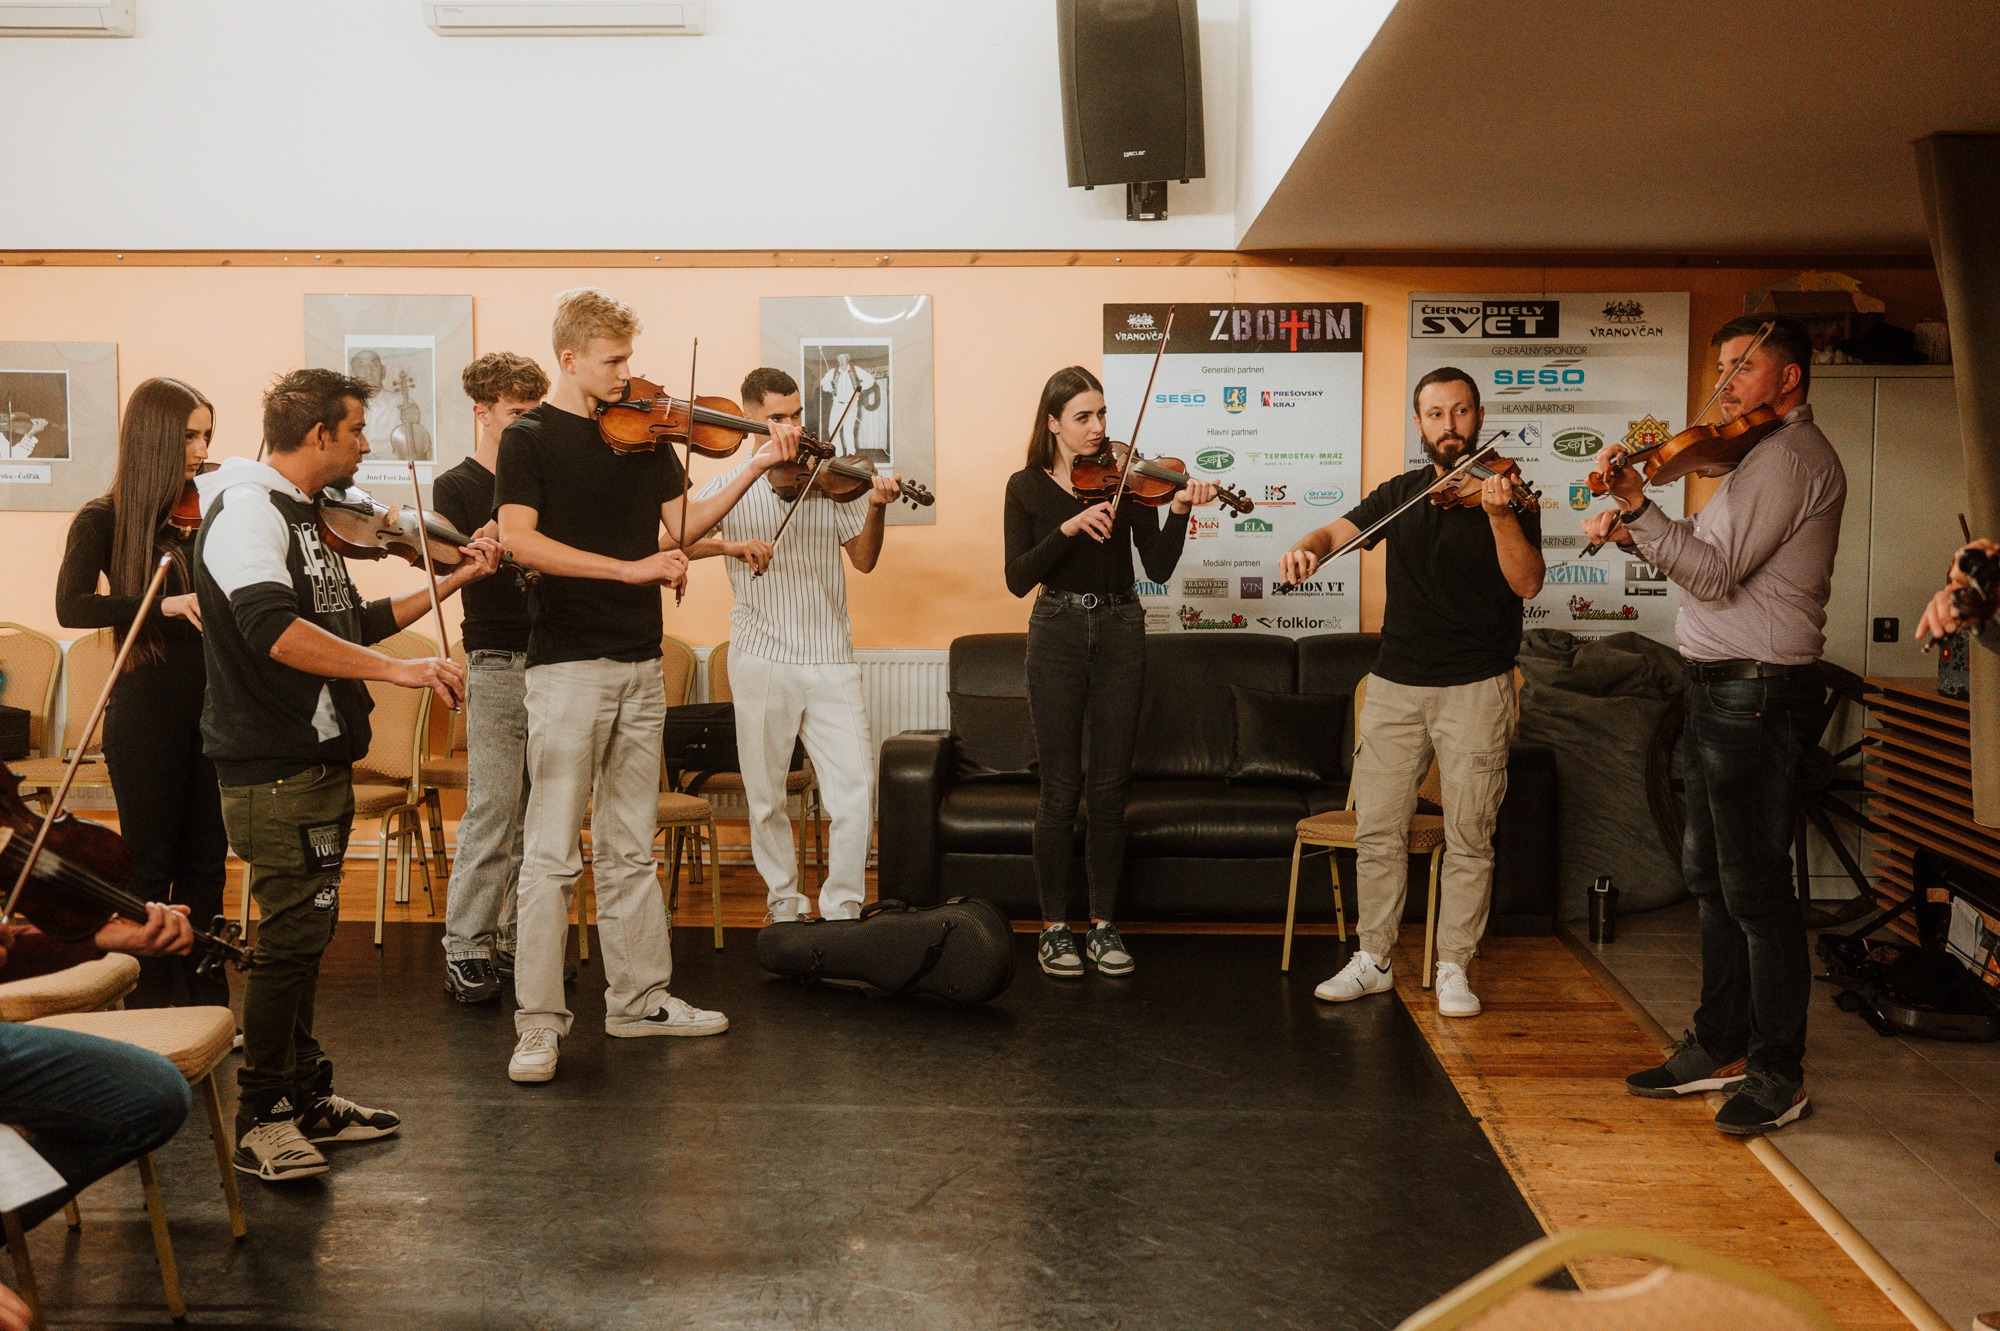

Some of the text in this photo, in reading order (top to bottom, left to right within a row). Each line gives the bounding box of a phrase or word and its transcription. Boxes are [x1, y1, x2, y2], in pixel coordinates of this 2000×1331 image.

[1421, 304, 1545, 315] ČIERNO BIELY
[1421, 316, 1545, 334] SVET
[1590, 324, 1663, 337] VRANOVČAN
[1491, 345, 1588, 355] GENERÁLNY SPONZOR
[1237, 366, 1265, 375] partneri
[1494, 369, 1585, 385] SESO
[1273, 389, 1324, 397] PREŠOVSKÝ
[1155, 394, 1206, 403] SESO
[1536, 404, 1575, 413] PARTNERI
[1231, 428, 1258, 437] partneri
[1244, 522, 1266, 531] ELA
[1541, 537, 1576, 546] ARTNERI
[1233, 559, 1261, 569] partneri
[1546, 565, 1607, 583] NOVINKY
[1631, 563, 1659, 579] TV
[1242, 582, 1262, 591] VTN
[1327, 582, 1345, 592] VT
[270, 1105, 294, 1114] adidas
